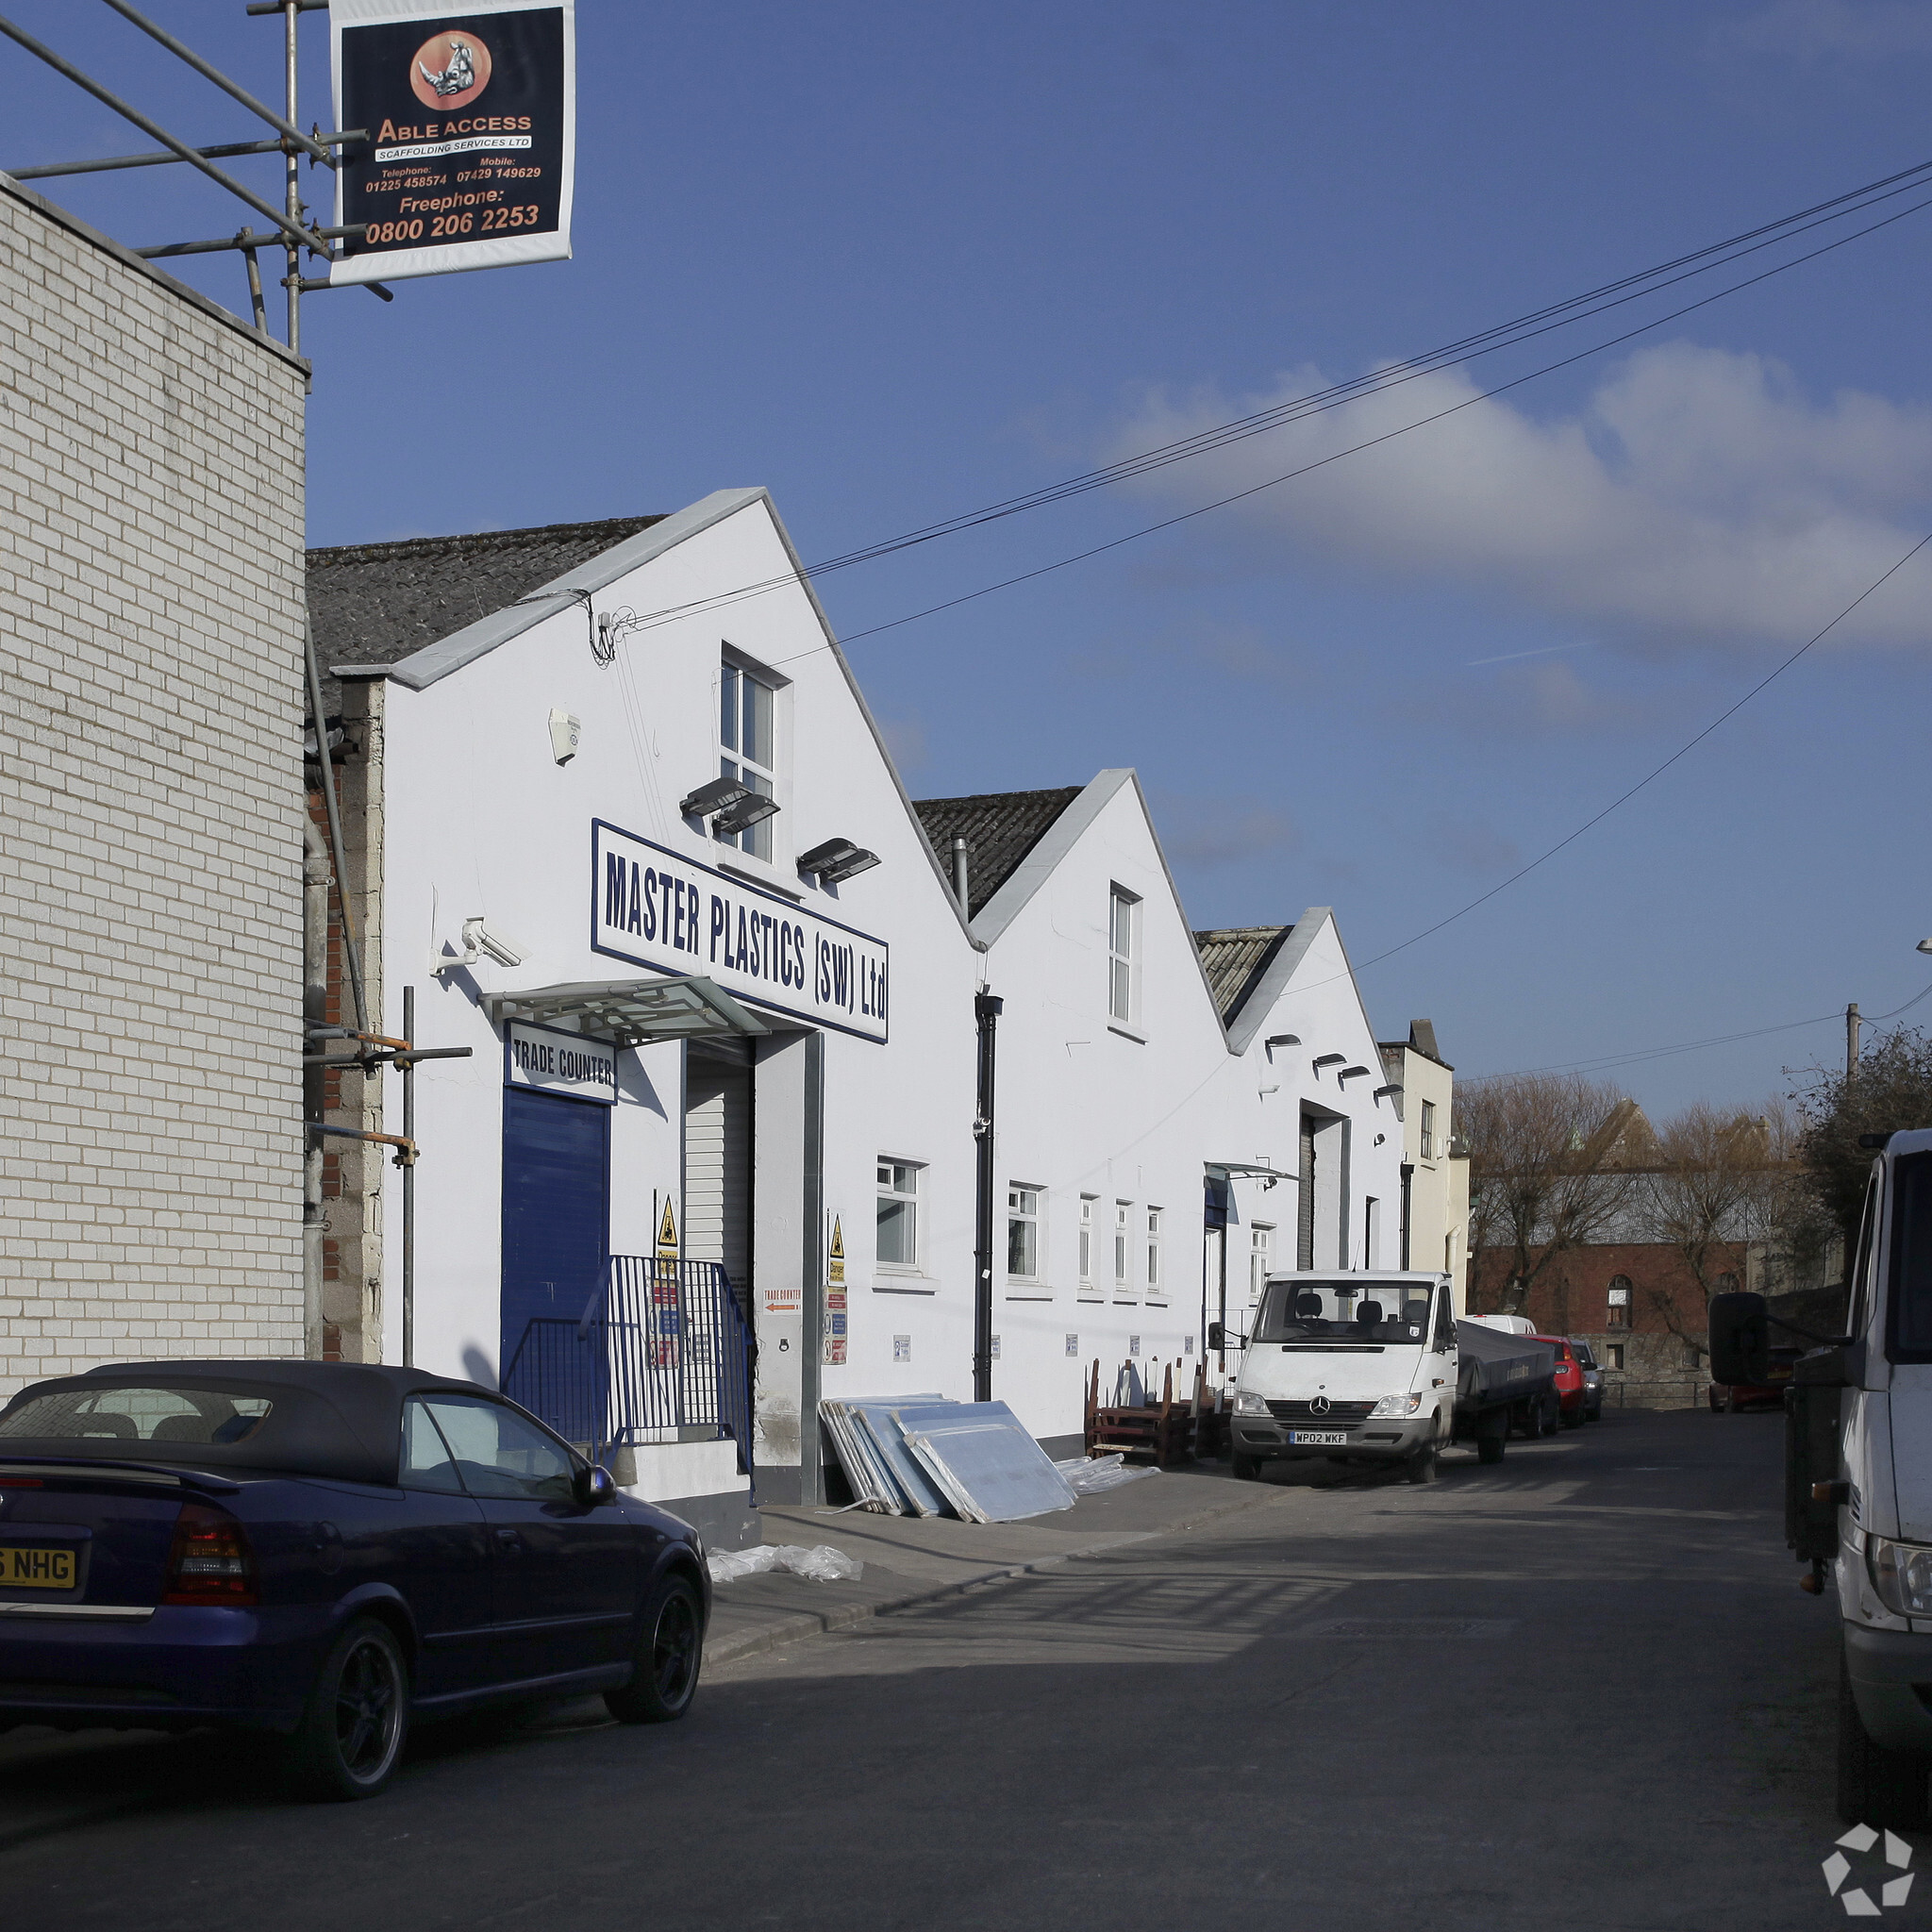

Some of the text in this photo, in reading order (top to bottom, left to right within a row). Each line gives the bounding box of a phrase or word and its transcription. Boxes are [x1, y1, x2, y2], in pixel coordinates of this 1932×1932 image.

[377, 116, 532, 142] ABLE ACCESS
[379, 138, 529, 159] SCAFFOLDING SERVICES LTD
[382, 166, 432, 179] Telephone:
[479, 157, 516, 167] Mobile:
[365, 175, 447, 192] 01225 458574
[457, 167, 541, 182] 07429 149629
[399, 190, 505, 213] Freephone:
[366, 205, 540, 244] 0800 206 2253
[606, 851, 885, 1020] MASTER PLASTICS (SW) Ltd
[514, 1039, 612, 1087] TRADE COUNTER
[764, 1290, 779, 1301] TRADE
[1296, 1433, 1344, 1443] WP02 WKF
[14, 1551, 69, 1580] NHG
